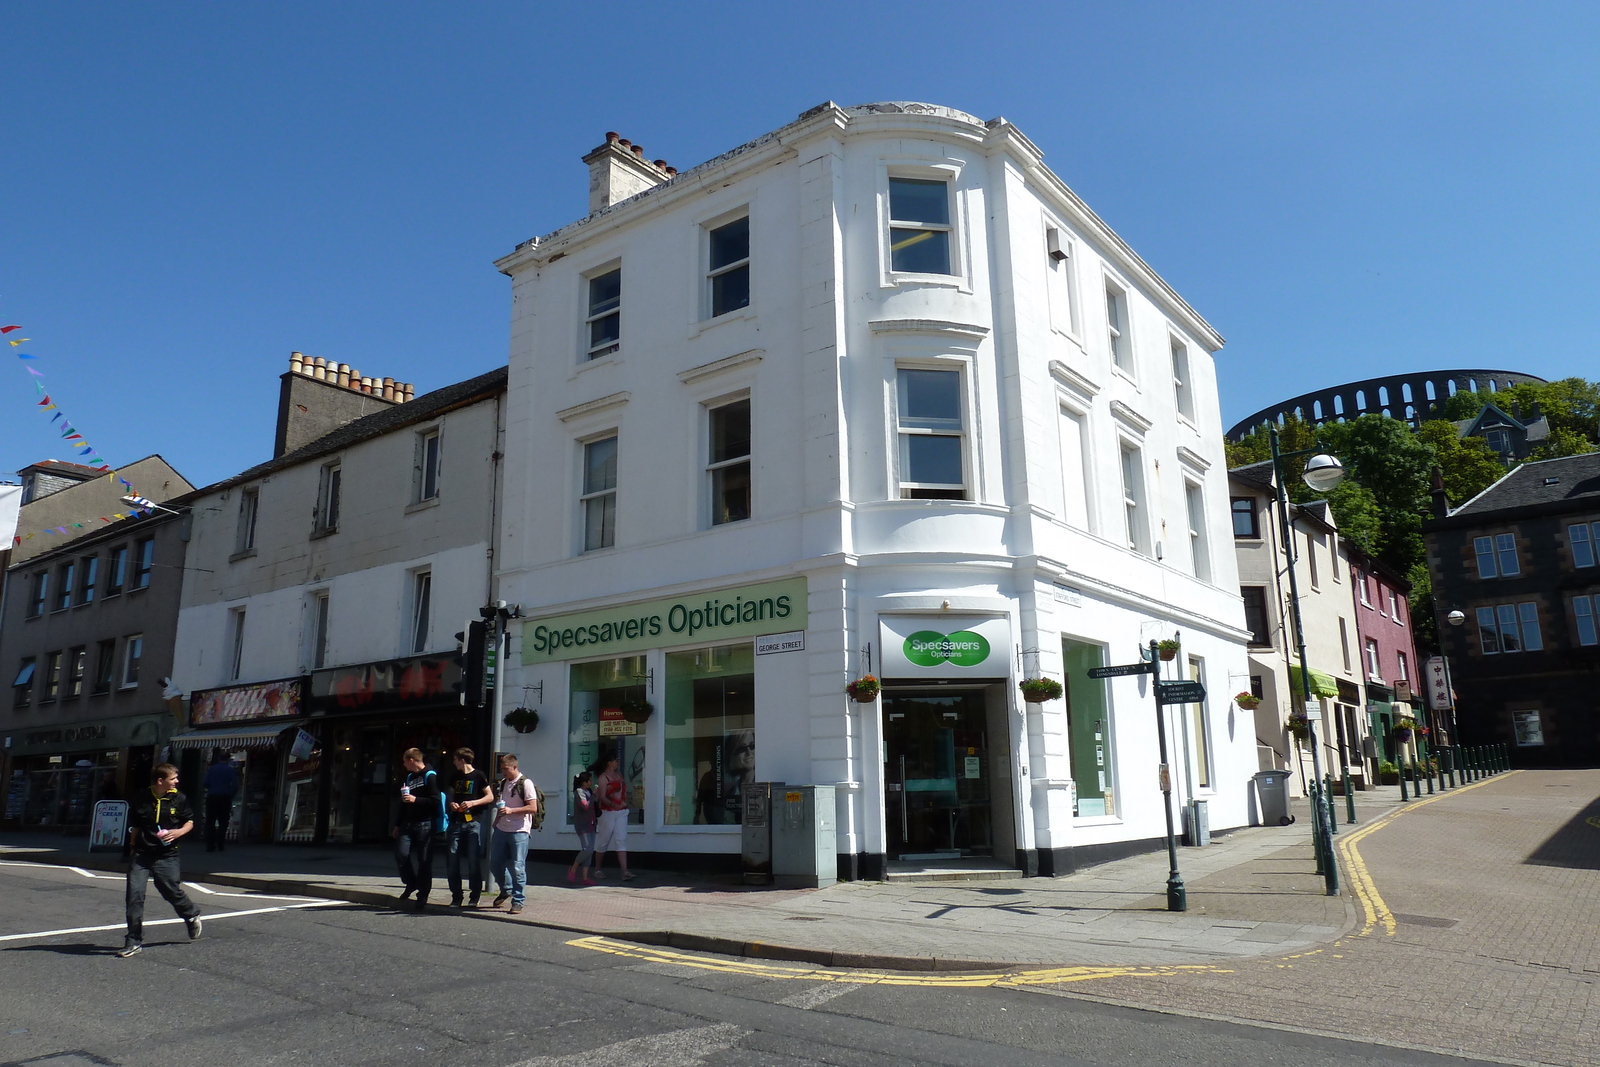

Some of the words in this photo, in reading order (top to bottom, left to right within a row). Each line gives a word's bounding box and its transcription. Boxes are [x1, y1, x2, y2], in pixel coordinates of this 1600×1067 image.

[533, 614, 661, 654] Specsavers
[667, 594, 792, 636] Opticians
[758, 643, 780, 652] GEORGE
[781, 640, 802, 649] STREET
[912, 639, 980, 652] Specsavers
[930, 650, 963, 658] Opticians
[578, 709, 592, 747] lenses
[298, 731, 315, 745] ICES
